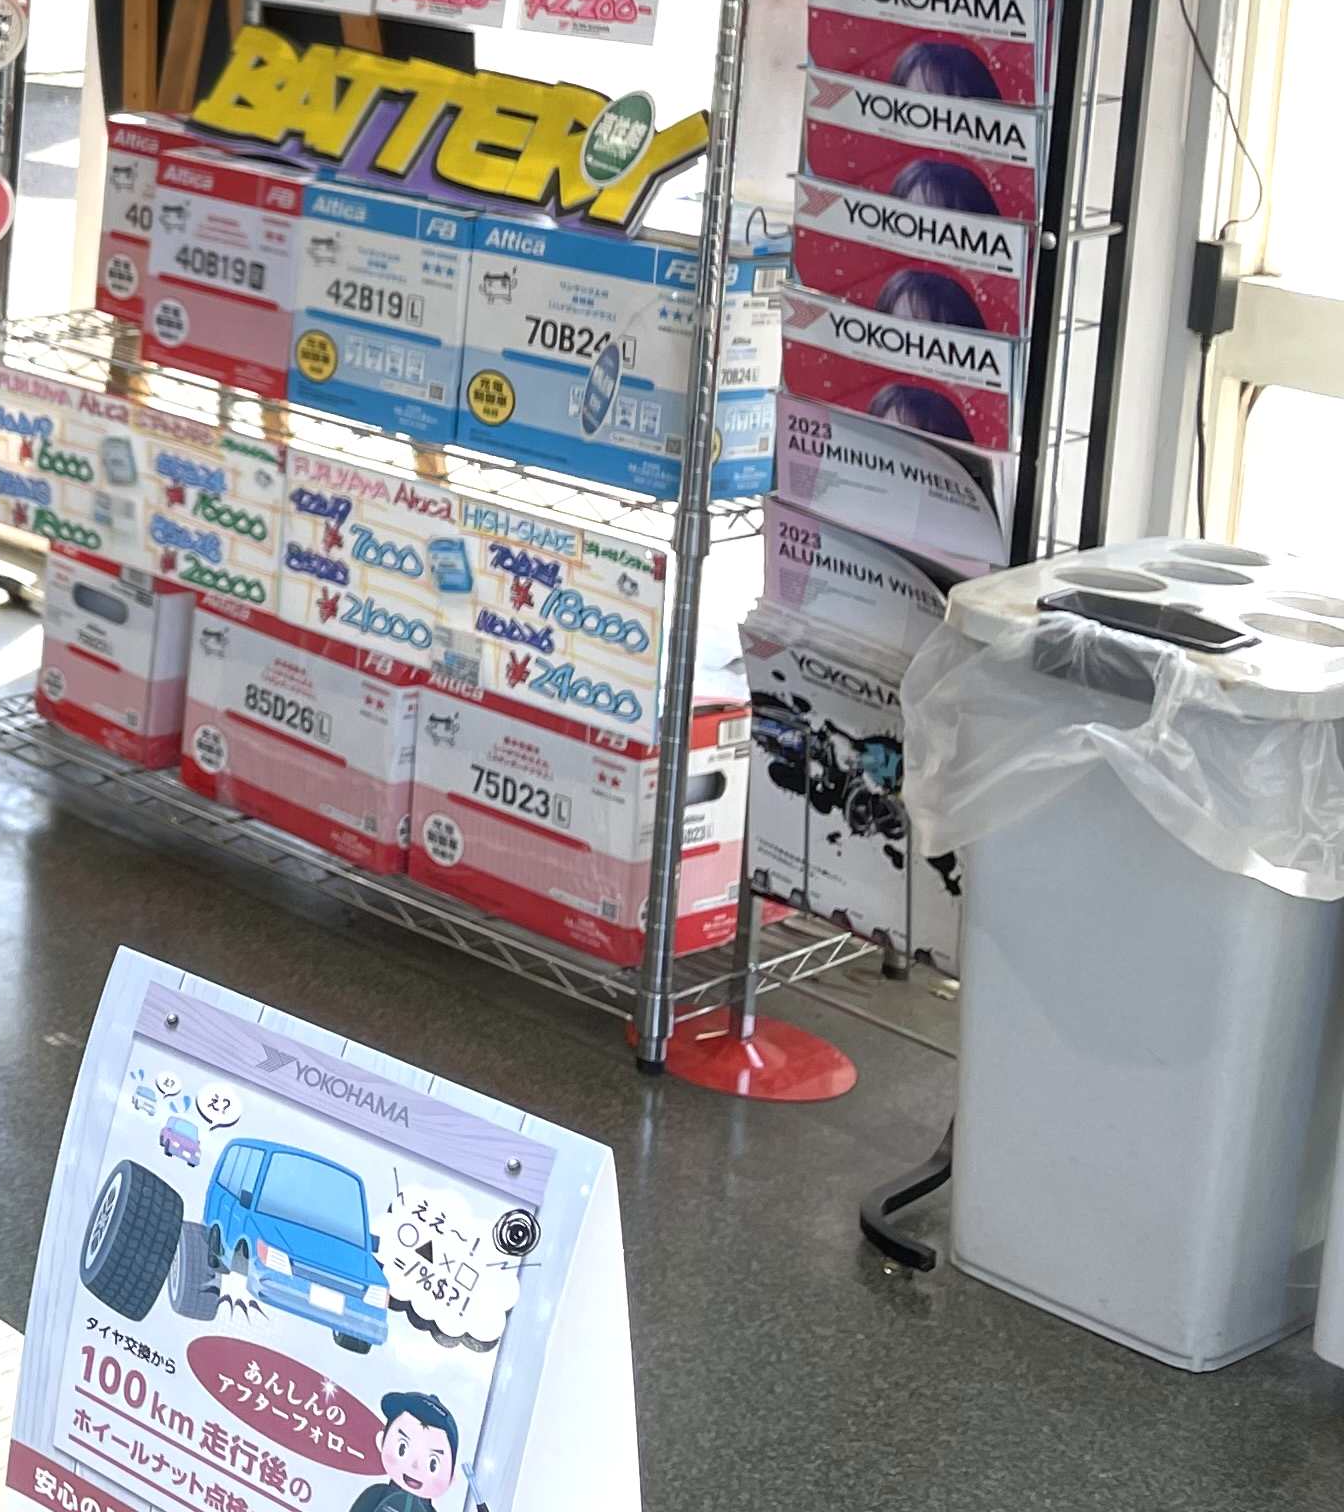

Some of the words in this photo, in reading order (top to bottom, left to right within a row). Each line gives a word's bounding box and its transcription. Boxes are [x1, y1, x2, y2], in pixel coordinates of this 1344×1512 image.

[114, 130, 160, 153] Altica
[192, 24, 709, 230] BATTERY
[854, 88, 1027, 150] YOKOHAMA
[163, 163, 215, 191] Altica
[313, 194, 368, 222] Altica
[842, 197, 1013, 260] YOKOHAMA
[174, 245, 247, 285] 40B19
[484, 227, 547, 257] Altica
[326, 280, 404, 320] 42B19
[524, 316, 612, 359] 70B24
[829, 310, 1000, 375] YOKOHAMA
[787, 414, 833, 441] 2023
[787, 436, 896, 475] ALUMINUM
[902, 461, 978, 504] WHEELS
[778, 521, 823, 550] 2023
[778, 543, 886, 588] ALUMINUM
[243, 685, 314, 734] 85D26
[470, 764, 551, 818] 75D23
[206, 1093, 231, 1115] え?
[290, 1058, 413, 1130] YOKOHAMA
[86, 1316, 177, 1375] タイヤ交換から
[216, 1373, 366, 1461] アフターフォロー
[243, 1359, 347, 1427] あんしんの
[79, 1344, 148, 1410] 100
[150, 1390, 196, 1441] km
[200, 1421, 313, 1504] 走行後の
